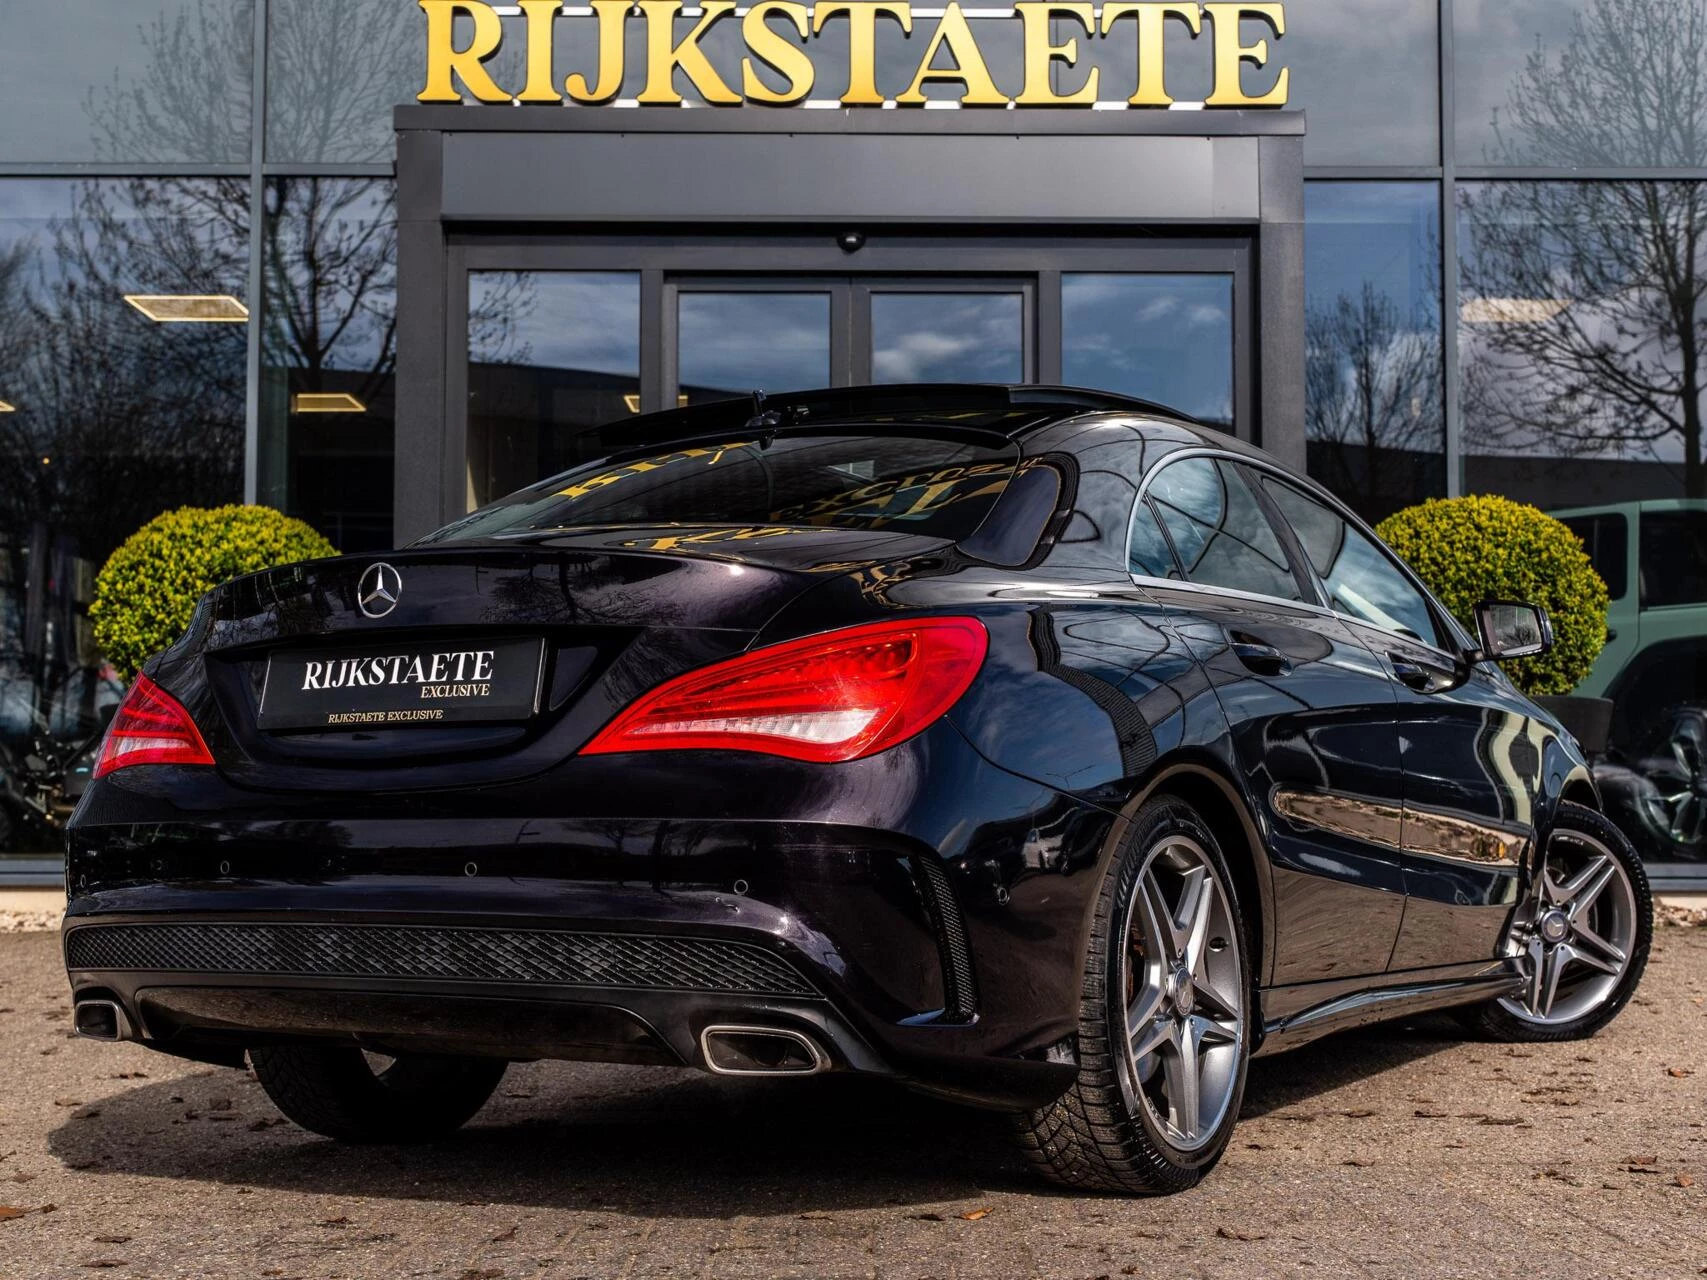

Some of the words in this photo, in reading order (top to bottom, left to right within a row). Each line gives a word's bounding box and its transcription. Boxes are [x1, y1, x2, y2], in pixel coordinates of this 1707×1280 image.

[416, 0, 1290, 106] RIJKSTAETE
[302, 651, 494, 690] RIJKSTAETE
[421, 684, 490, 698] EXCLUSIVE
[328, 711, 385, 724] RIJKSTAETE
[387, 710, 444, 721] EXCLUSIVE
